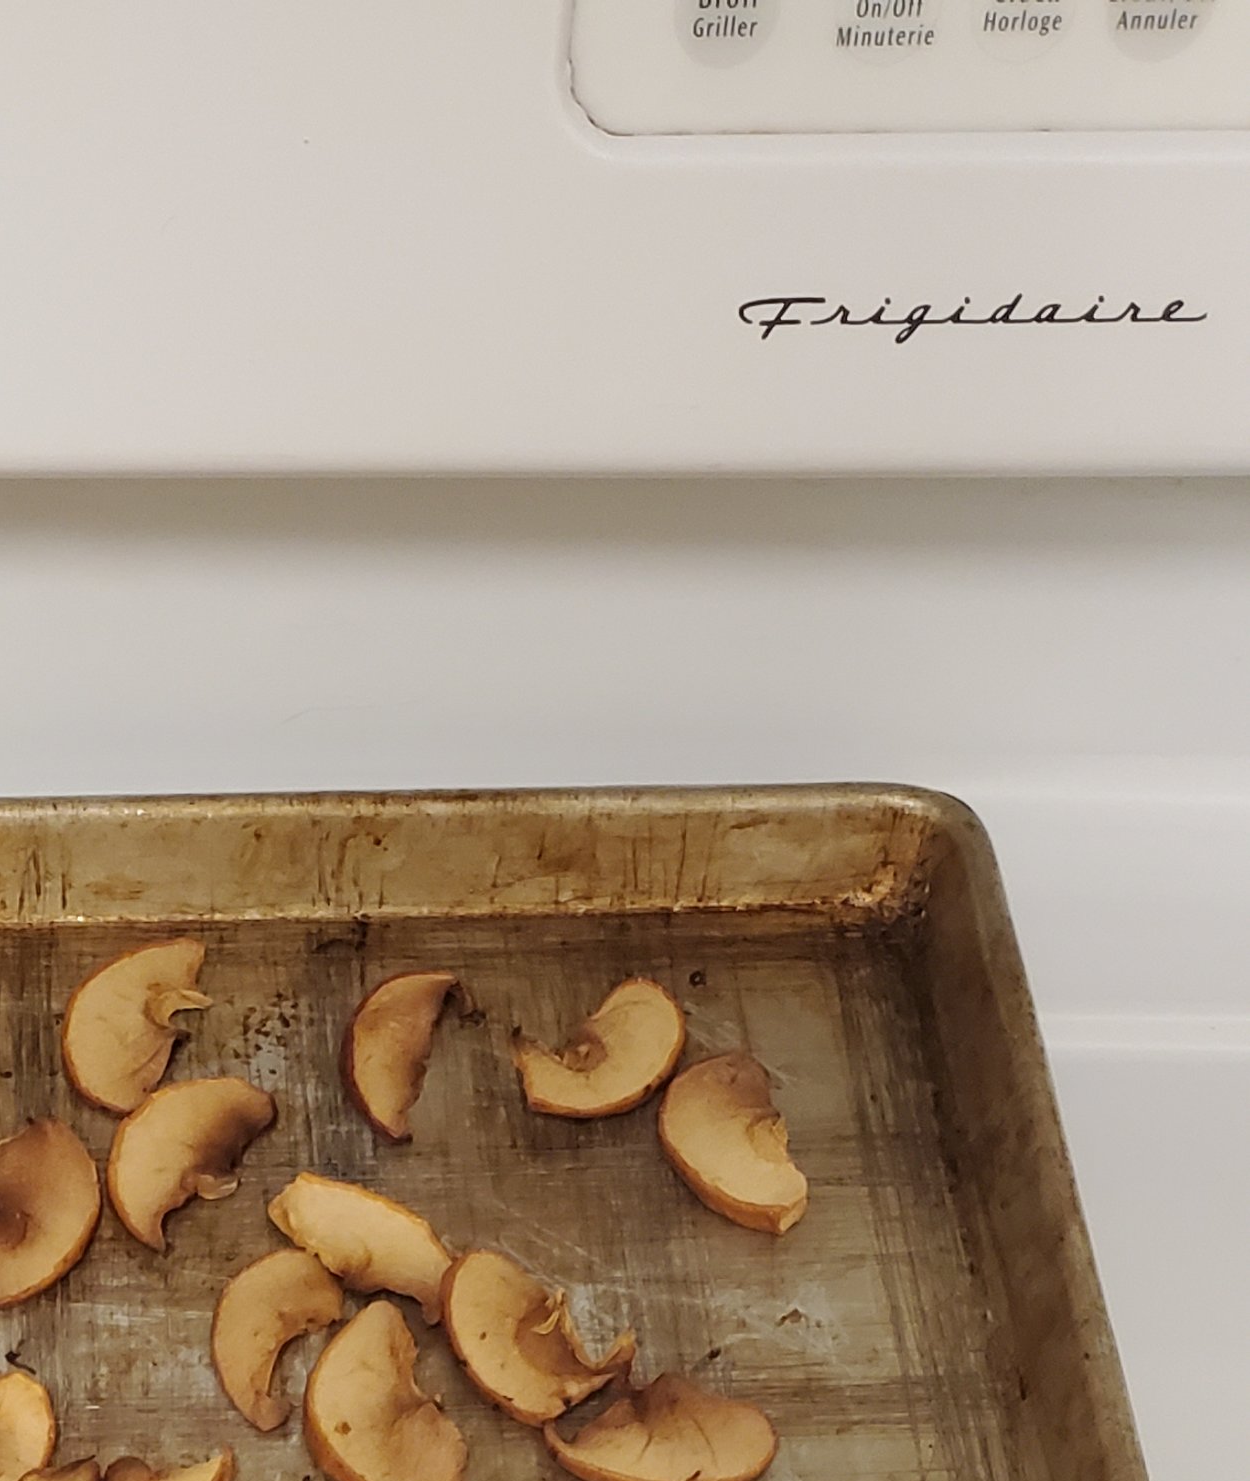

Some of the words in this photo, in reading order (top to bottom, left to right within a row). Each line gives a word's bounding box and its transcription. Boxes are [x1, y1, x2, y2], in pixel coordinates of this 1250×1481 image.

[692, 14, 759, 38] Griller
[982, 9, 1063, 37] Horloge
[1116, 8, 1199, 30] Annuler
[835, 24, 935, 47] Minuterie
[738, 292, 1208, 345] Frigidaire
